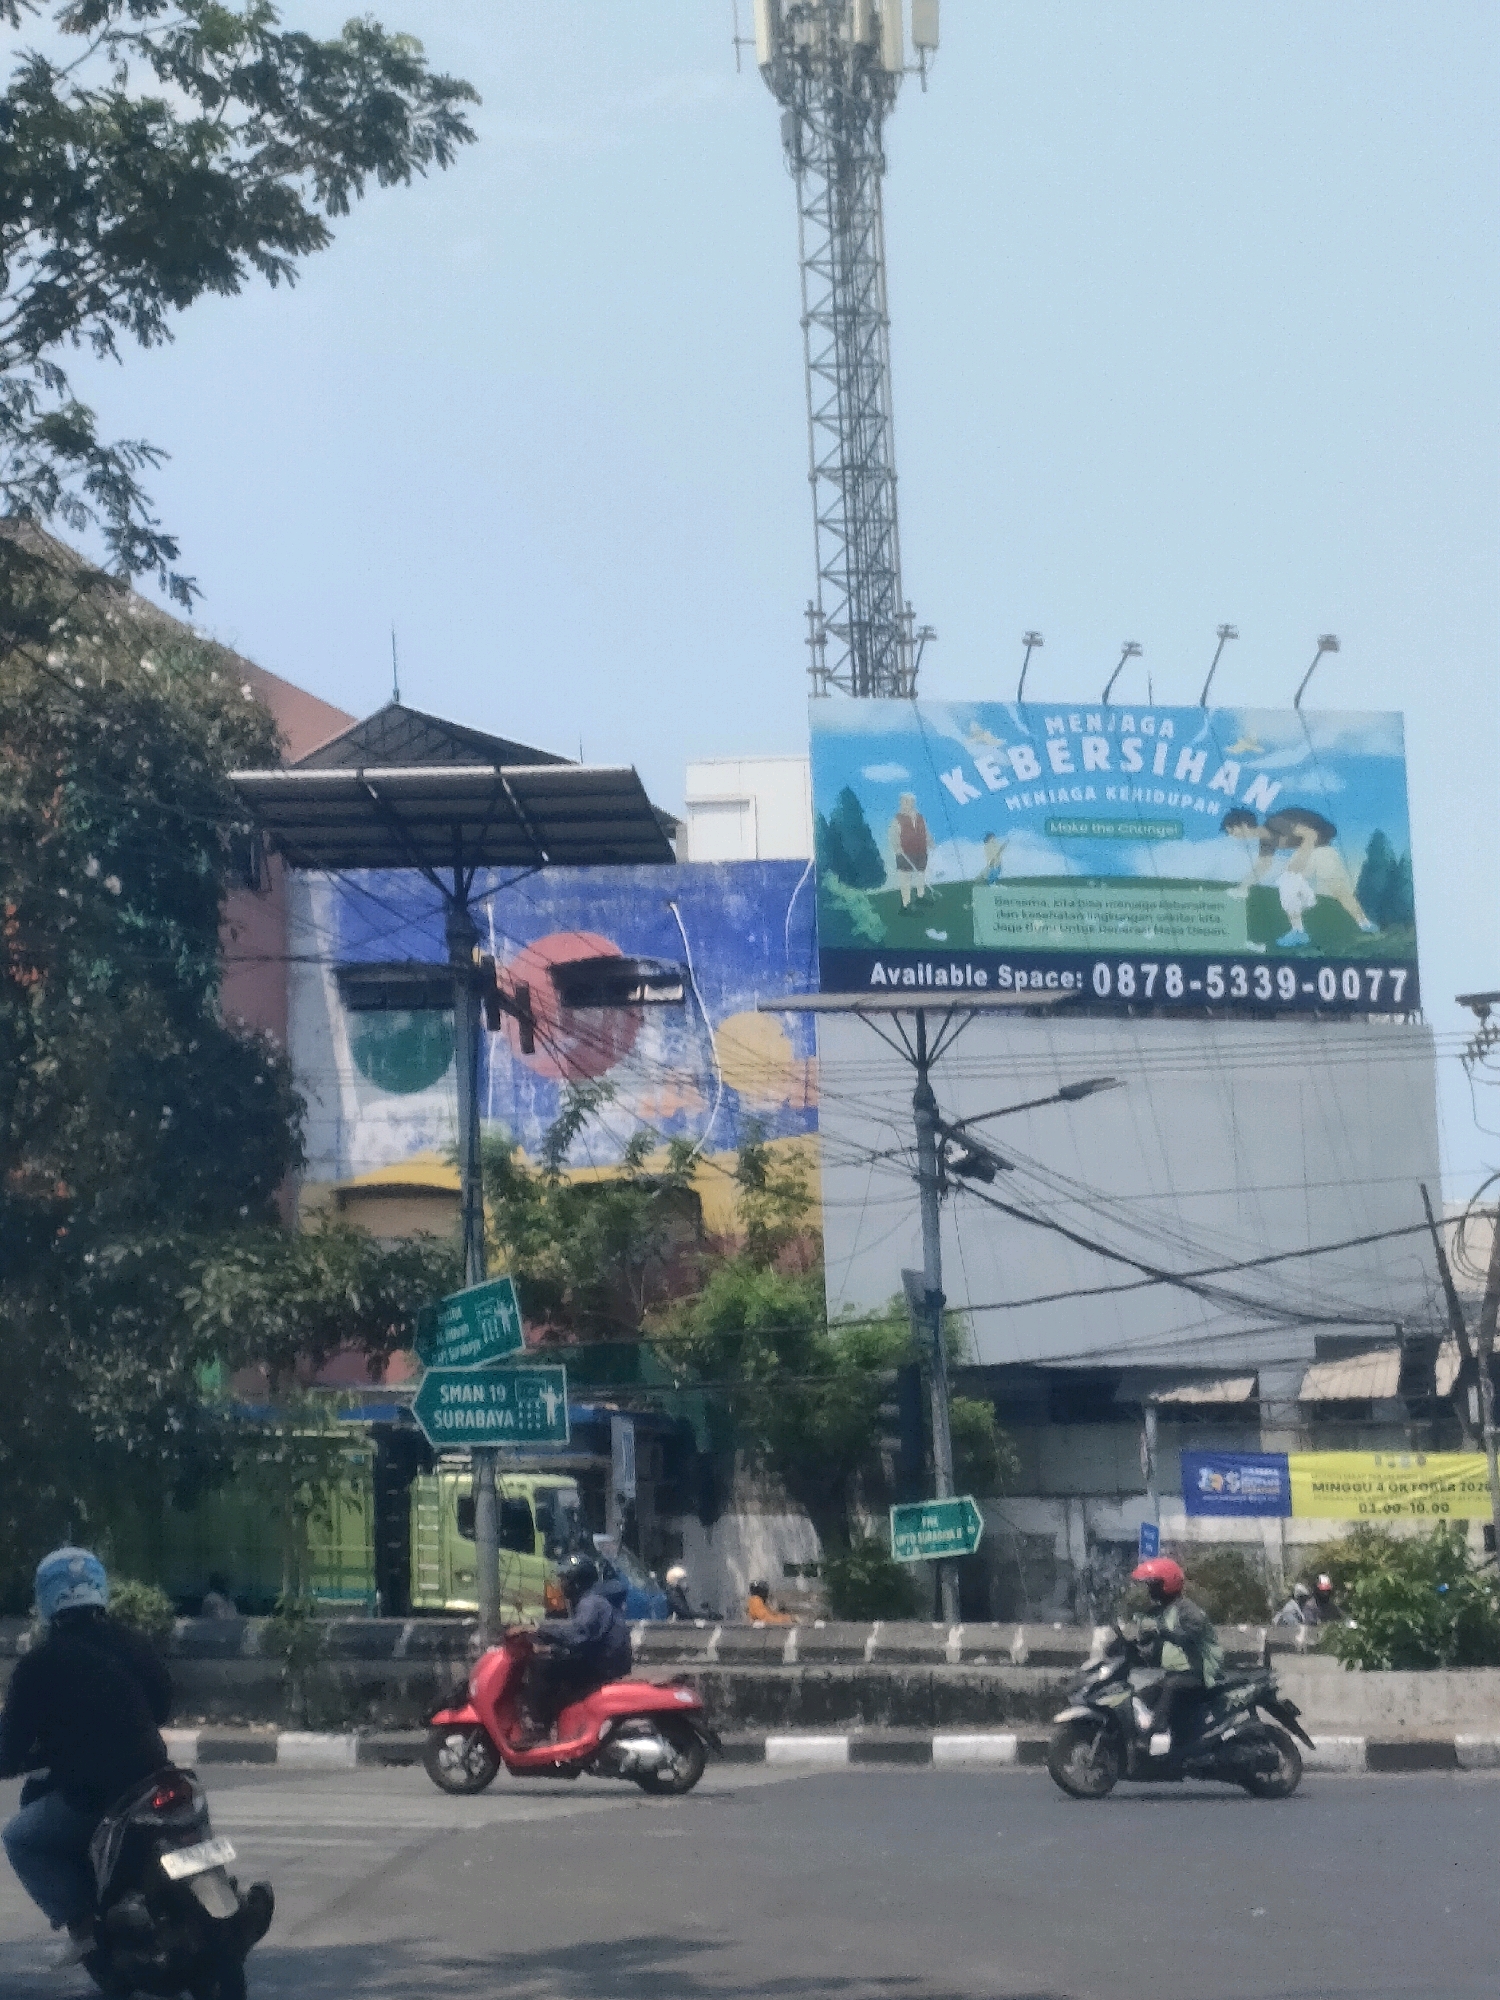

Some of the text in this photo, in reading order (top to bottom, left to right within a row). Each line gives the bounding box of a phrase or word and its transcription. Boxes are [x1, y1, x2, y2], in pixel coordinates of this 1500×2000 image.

[1045, 713, 1174, 739] MENJAGA
[940, 737, 1282, 813] KEBERSIHAN
[1005, 785, 1220, 816] MENJAGA KEHIDUPAN
[1091, 822, 1115, 834] the
[870, 962, 1407, 1002] Available Space: 0878-5339-0077
[440, 1384, 485, 1403] SMAN
[433, 1409, 514, 1430] SURABAYA
[1311, 1482, 1372, 1493] MINGGU
